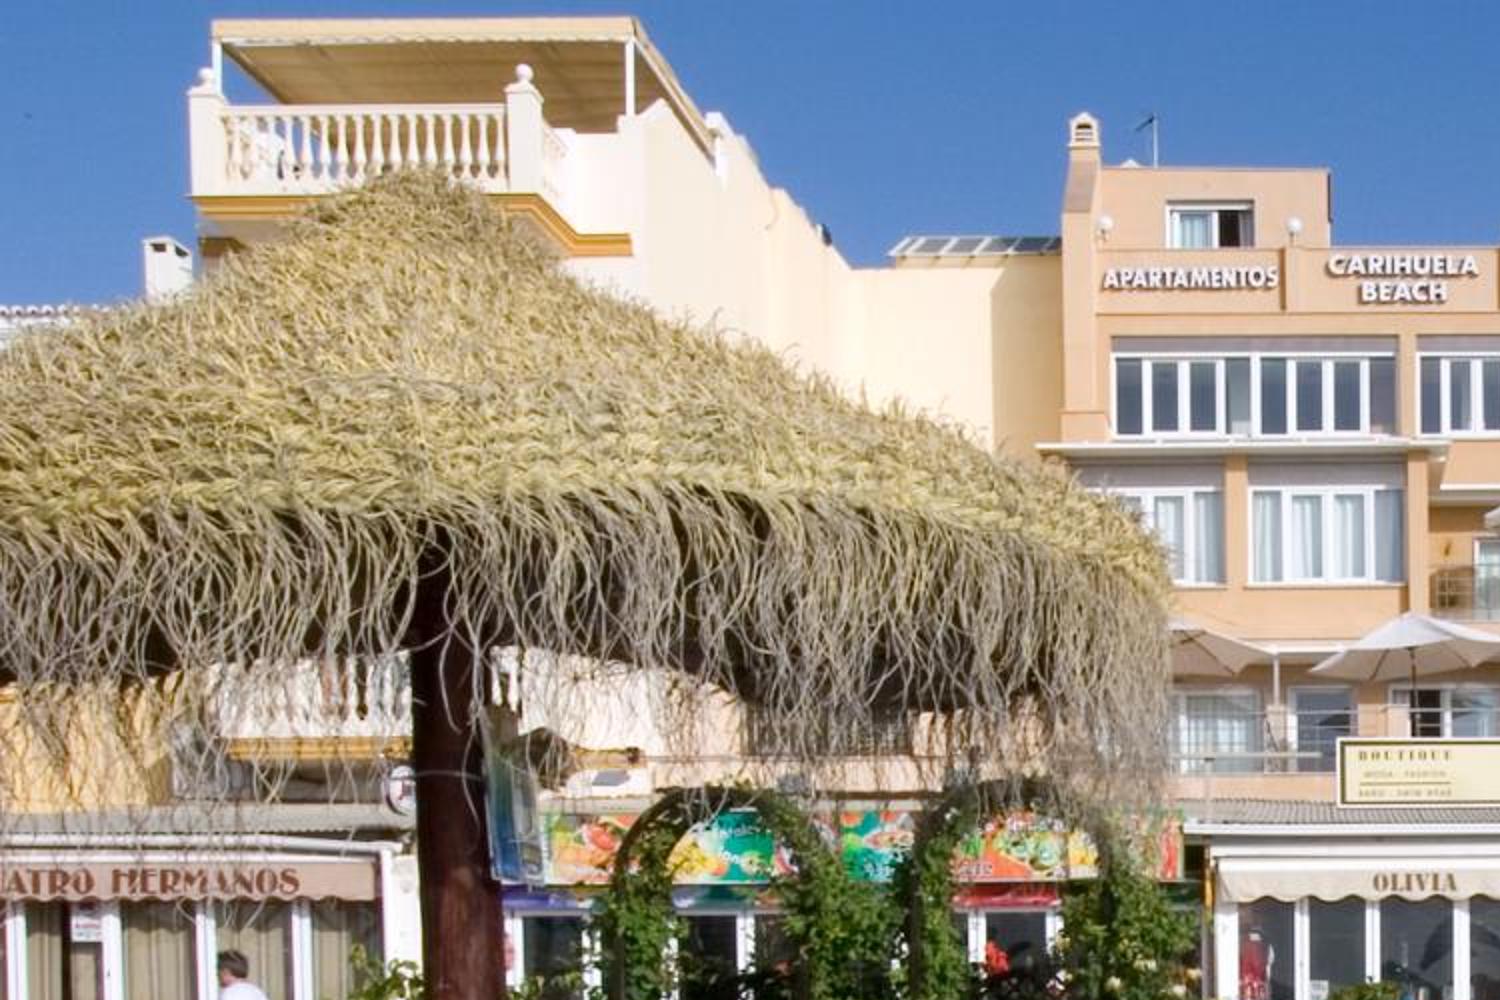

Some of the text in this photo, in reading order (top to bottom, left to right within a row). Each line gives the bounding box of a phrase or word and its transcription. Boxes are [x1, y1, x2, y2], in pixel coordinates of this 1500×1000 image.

[1327, 255, 1479, 277] CARIHUELA
[1103, 267, 1280, 290] APARTAMENTOS
[1360, 281, 1448, 304] BEACH
[2, 868, 95, 895] ATRO
[1372, 873, 1457, 891] OLIVIA
